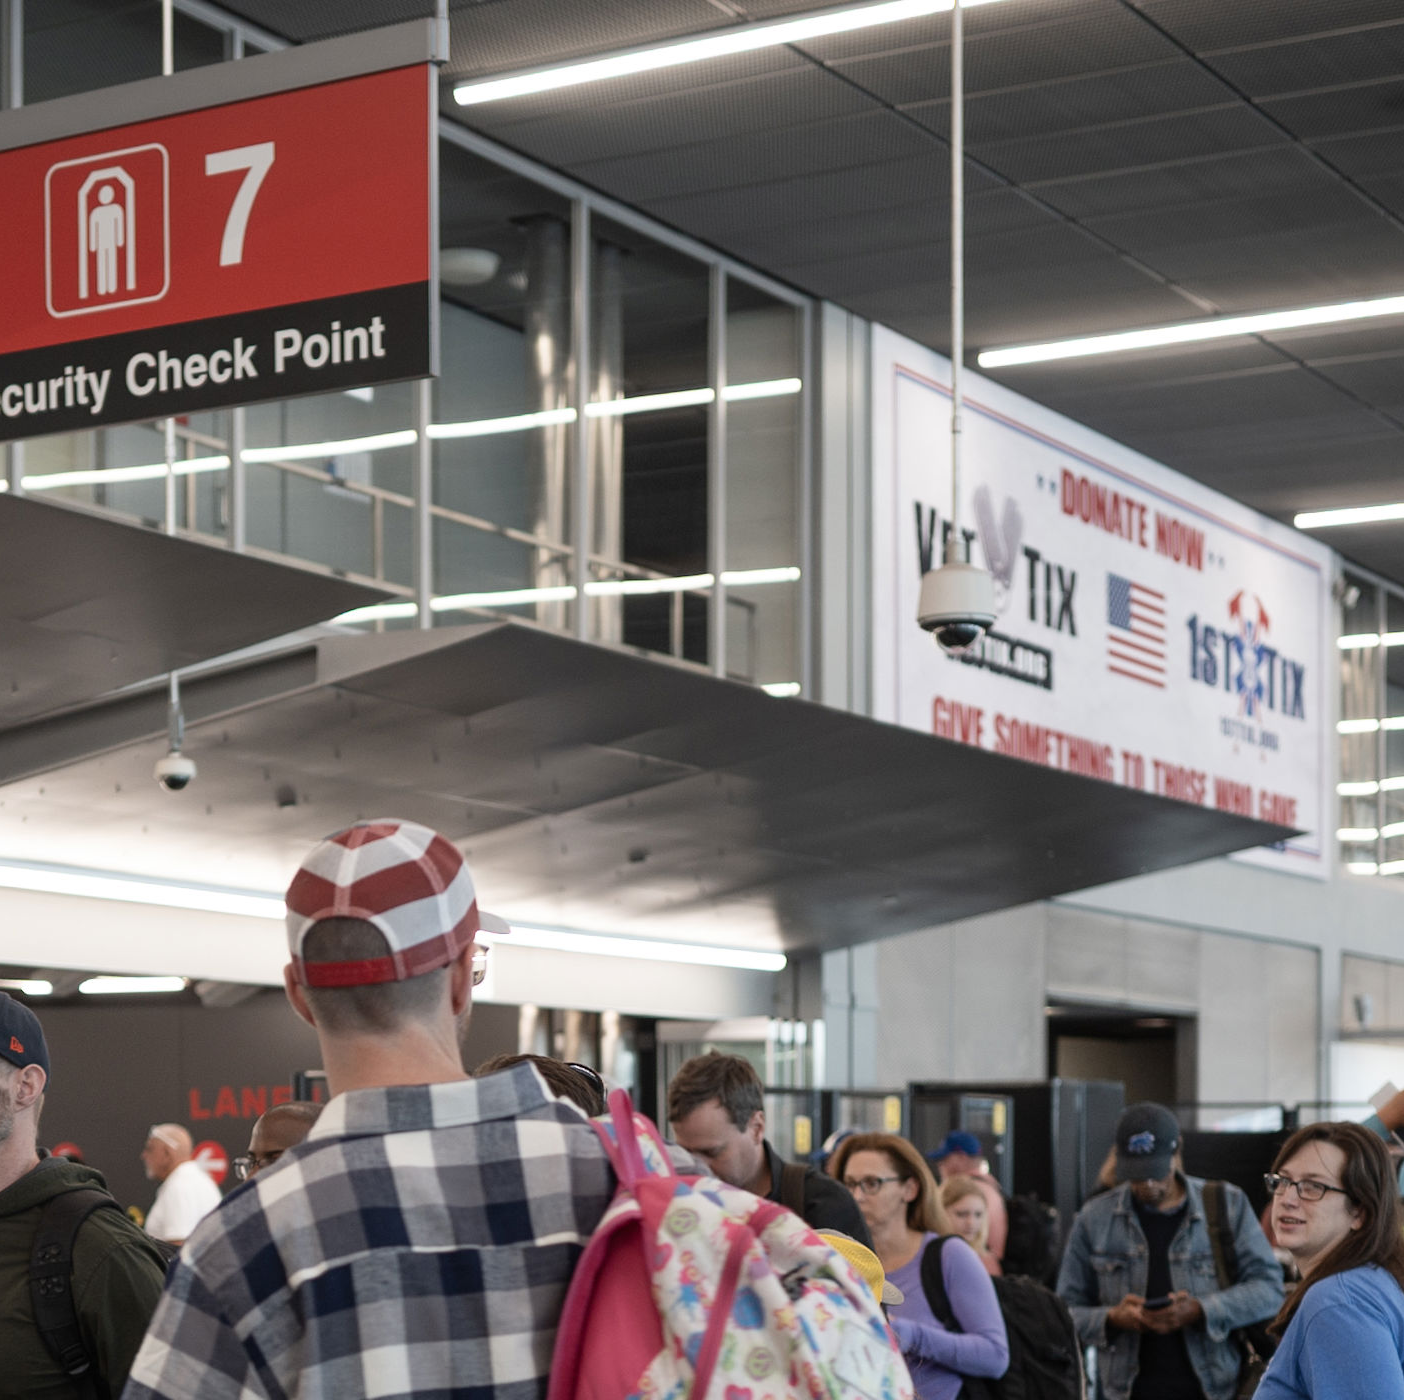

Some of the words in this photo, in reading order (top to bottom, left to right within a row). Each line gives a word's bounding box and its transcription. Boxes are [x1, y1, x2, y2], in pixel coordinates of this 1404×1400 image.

[204, 141, 276, 267] 7
[125, 337, 259, 397] Check
[274, 316, 387, 374] Point
[1061, 468, 1148, 548] DONATE
[1155, 511, 1205, 572] NOW
[1022, 544, 1078, 637] TIX
[1187, 613, 1234, 693] 1ST
[1262, 645, 1306, 721] TIX
[933, 695, 984, 748] GIVE
[994, 713, 1114, 783] SOMETHING
[1121, 748, 1145, 791] TO
[1152, 758, 1207, 806] THOSE
[1213, 776, 1253, 818] WHO
[1259, 788, 1297, 829] GAVE
